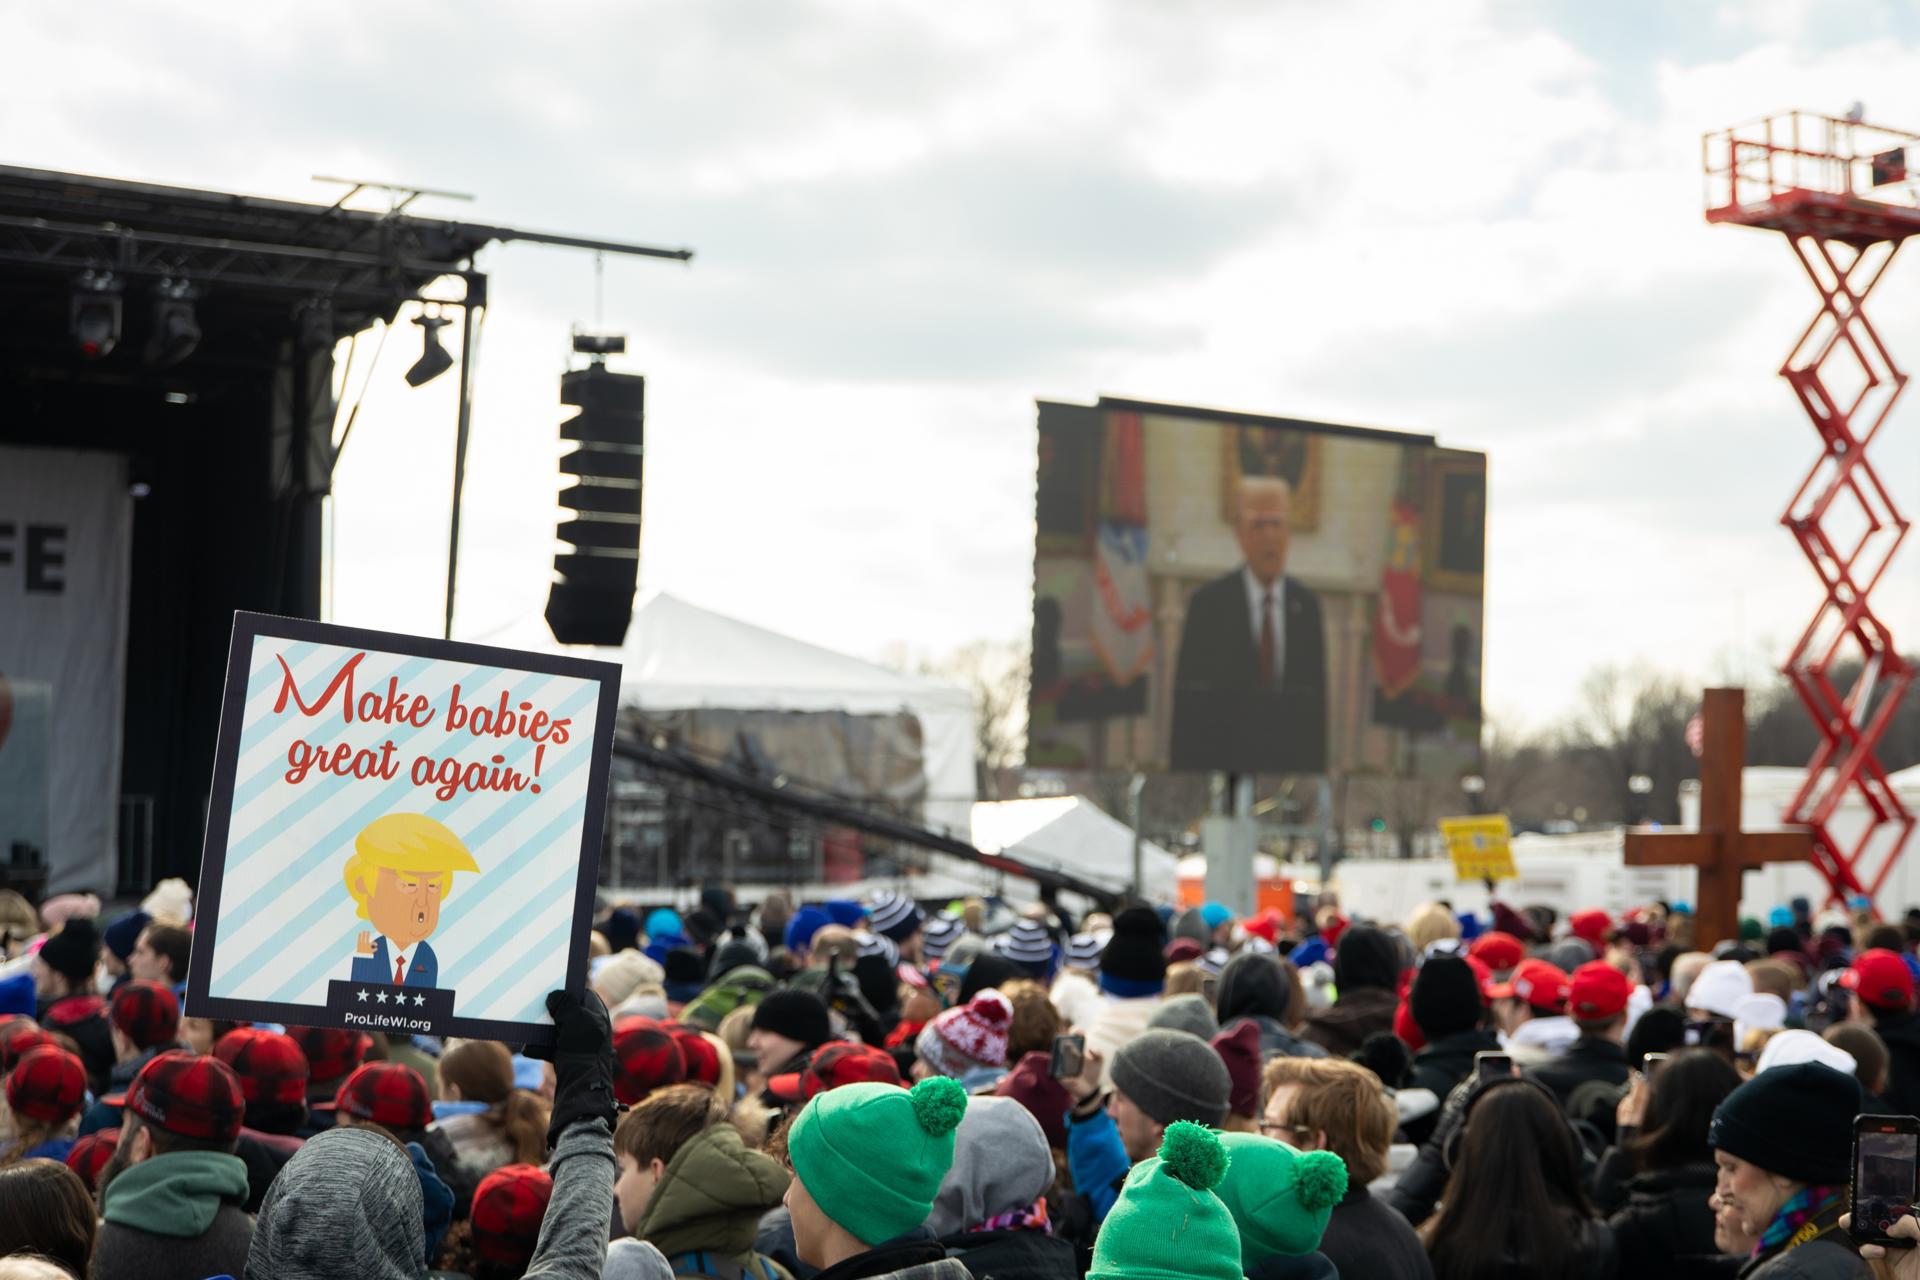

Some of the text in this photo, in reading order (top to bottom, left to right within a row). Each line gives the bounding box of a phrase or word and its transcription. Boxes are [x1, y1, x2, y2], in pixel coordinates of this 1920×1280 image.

[273, 652, 572, 746] Make babies
[284, 739, 545, 801] great again!
[344, 1012, 431, 1032] ProLifeWI.org
